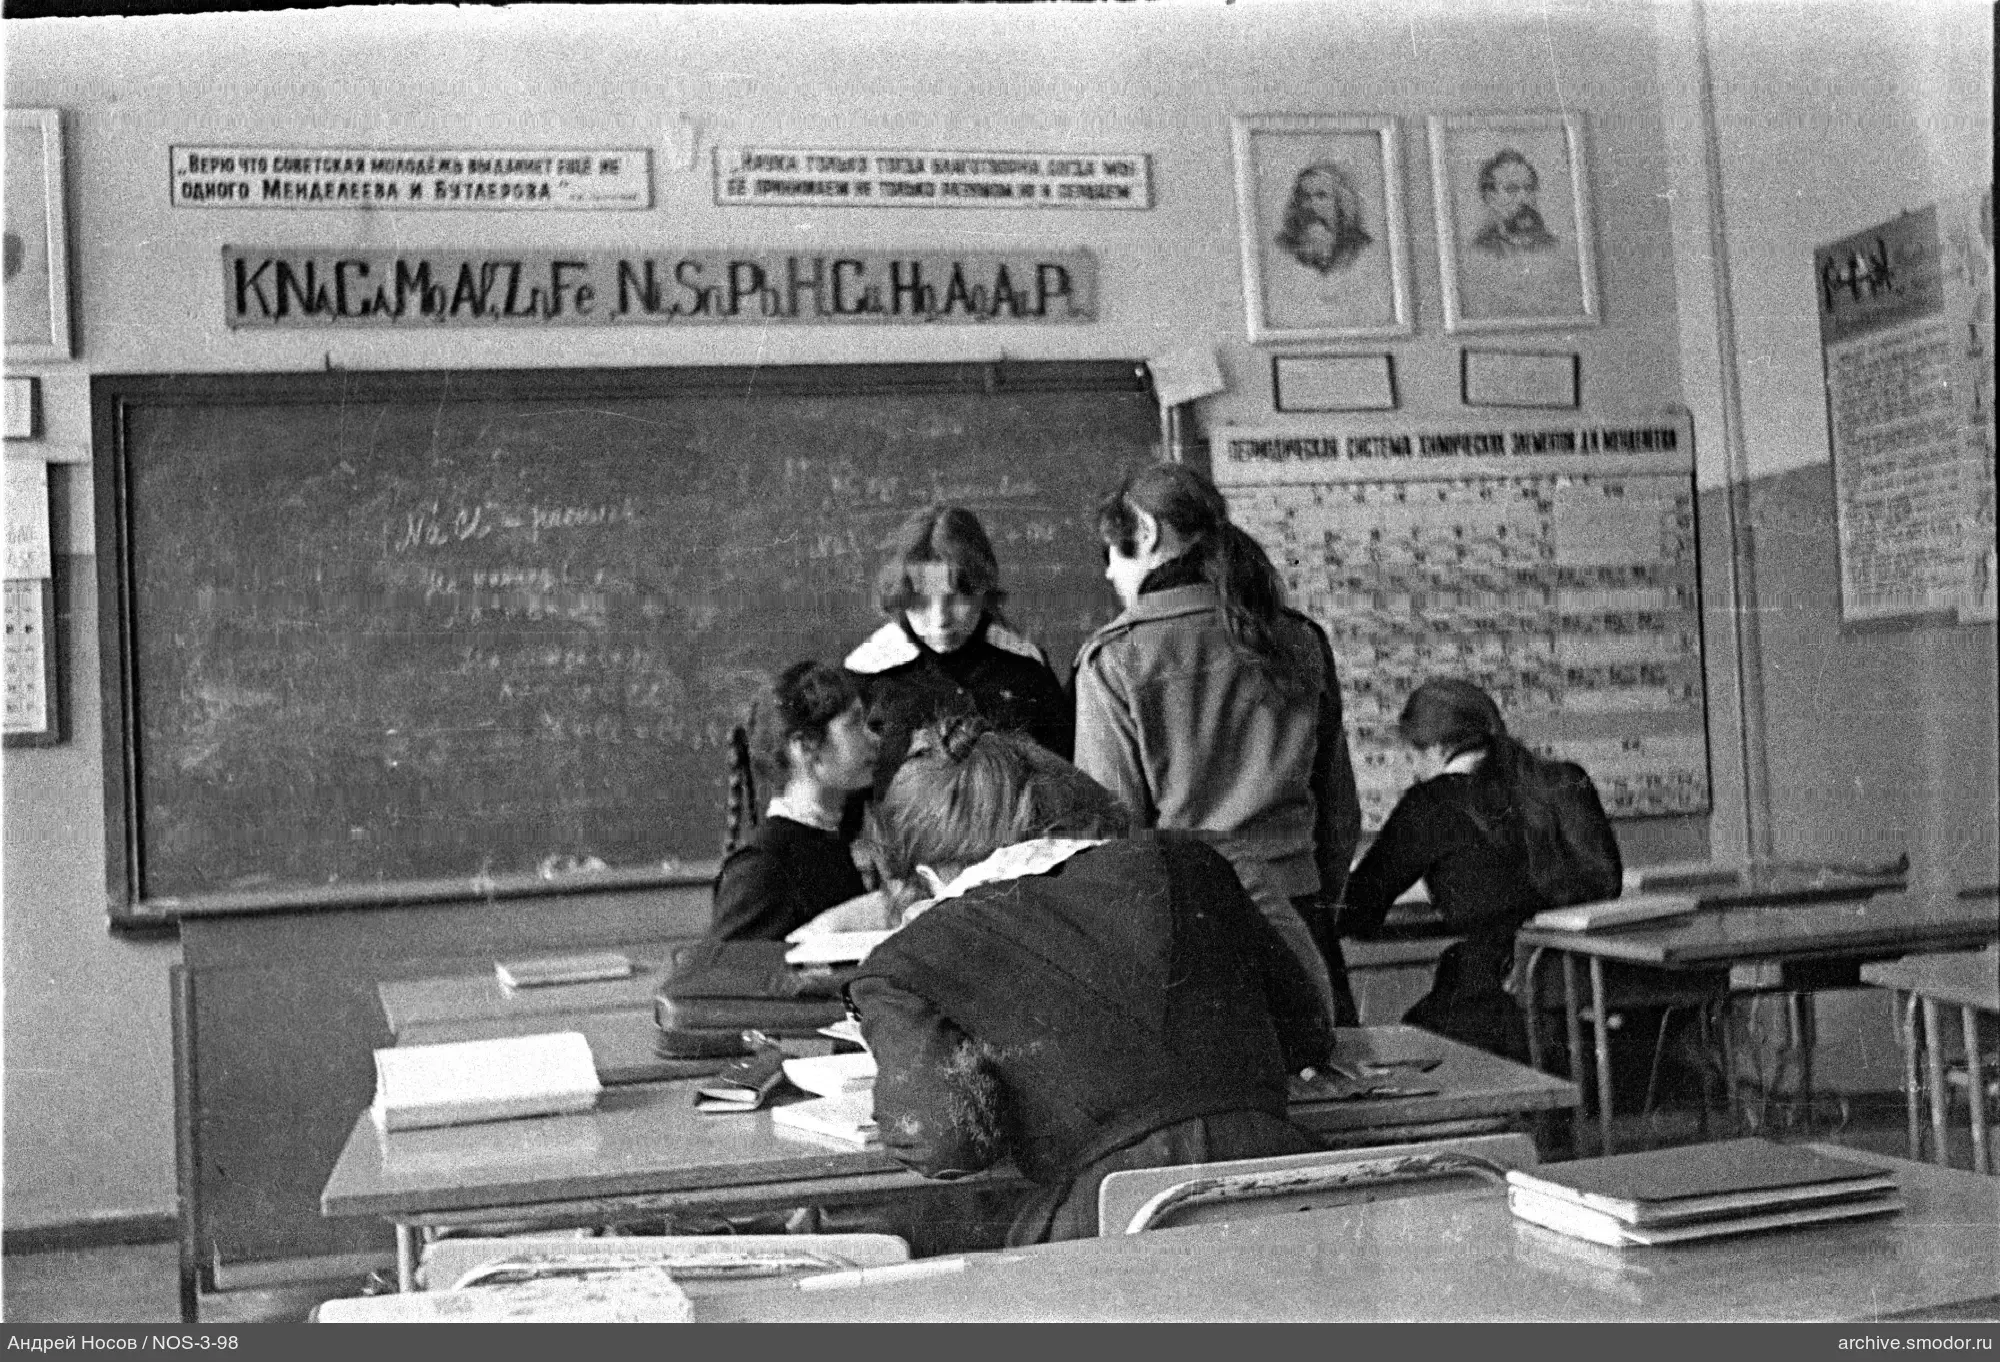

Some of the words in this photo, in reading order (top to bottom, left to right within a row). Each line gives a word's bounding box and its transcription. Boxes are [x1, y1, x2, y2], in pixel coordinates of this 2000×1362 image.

[239, 156, 268, 175] ЧТО
[273, 156, 365, 175] СОВЕТСКАЯ
[181, 181, 250, 201] ОДНОГО
[261, 178, 399, 201] МЕНДЕЛЕЕВА
[410, 182, 423, 200] И
